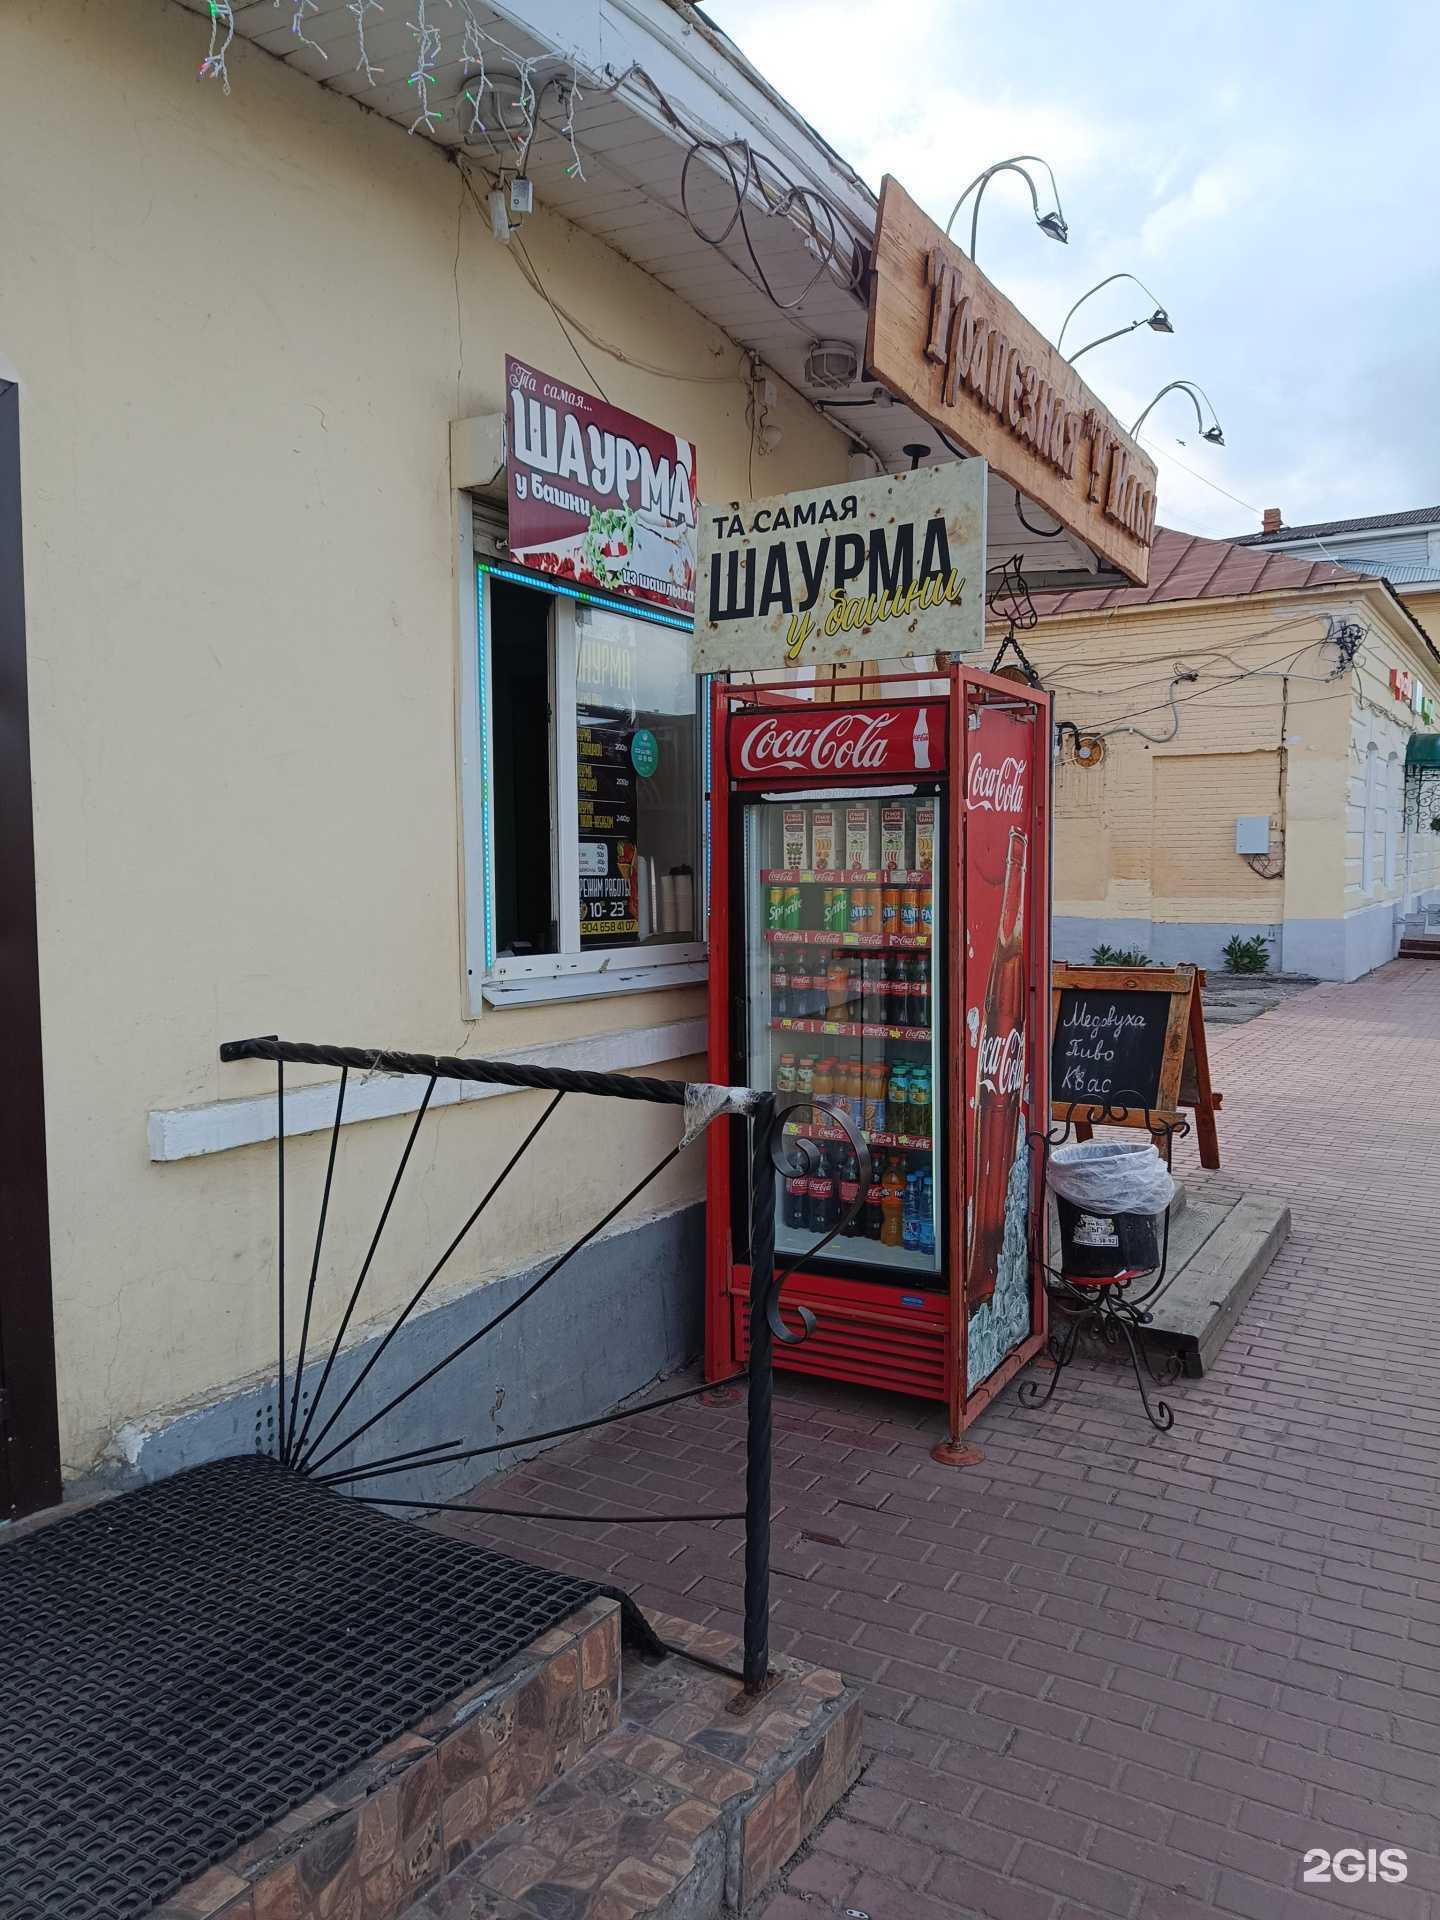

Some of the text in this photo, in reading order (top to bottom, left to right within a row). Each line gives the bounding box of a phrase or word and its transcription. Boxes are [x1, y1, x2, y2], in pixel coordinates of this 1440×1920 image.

[509, 362, 593, 412] Та самая...
[510, 389, 694, 530] ШАУРМА
[515, 472, 527, 500] у
[712, 495, 858, 540] ТА САМАЯ
[622, 568, 694, 602] из шашлыка
[709, 516, 951, 622] ШАУРМА
[824, 568, 966, 637] башни
[741, 713, 900, 772] Coca-Cola
[967, 752, 1027, 813] Coca-Cola
[581, 920, 635, 933] 904 658 41 07
[610, 901, 625, 917] 23
[1063, 1001, 1147, 1038] Медовуха
[1065, 1039, 1114, 1061] Пиво
[1061, 1065, 1112, 1093] Квас
